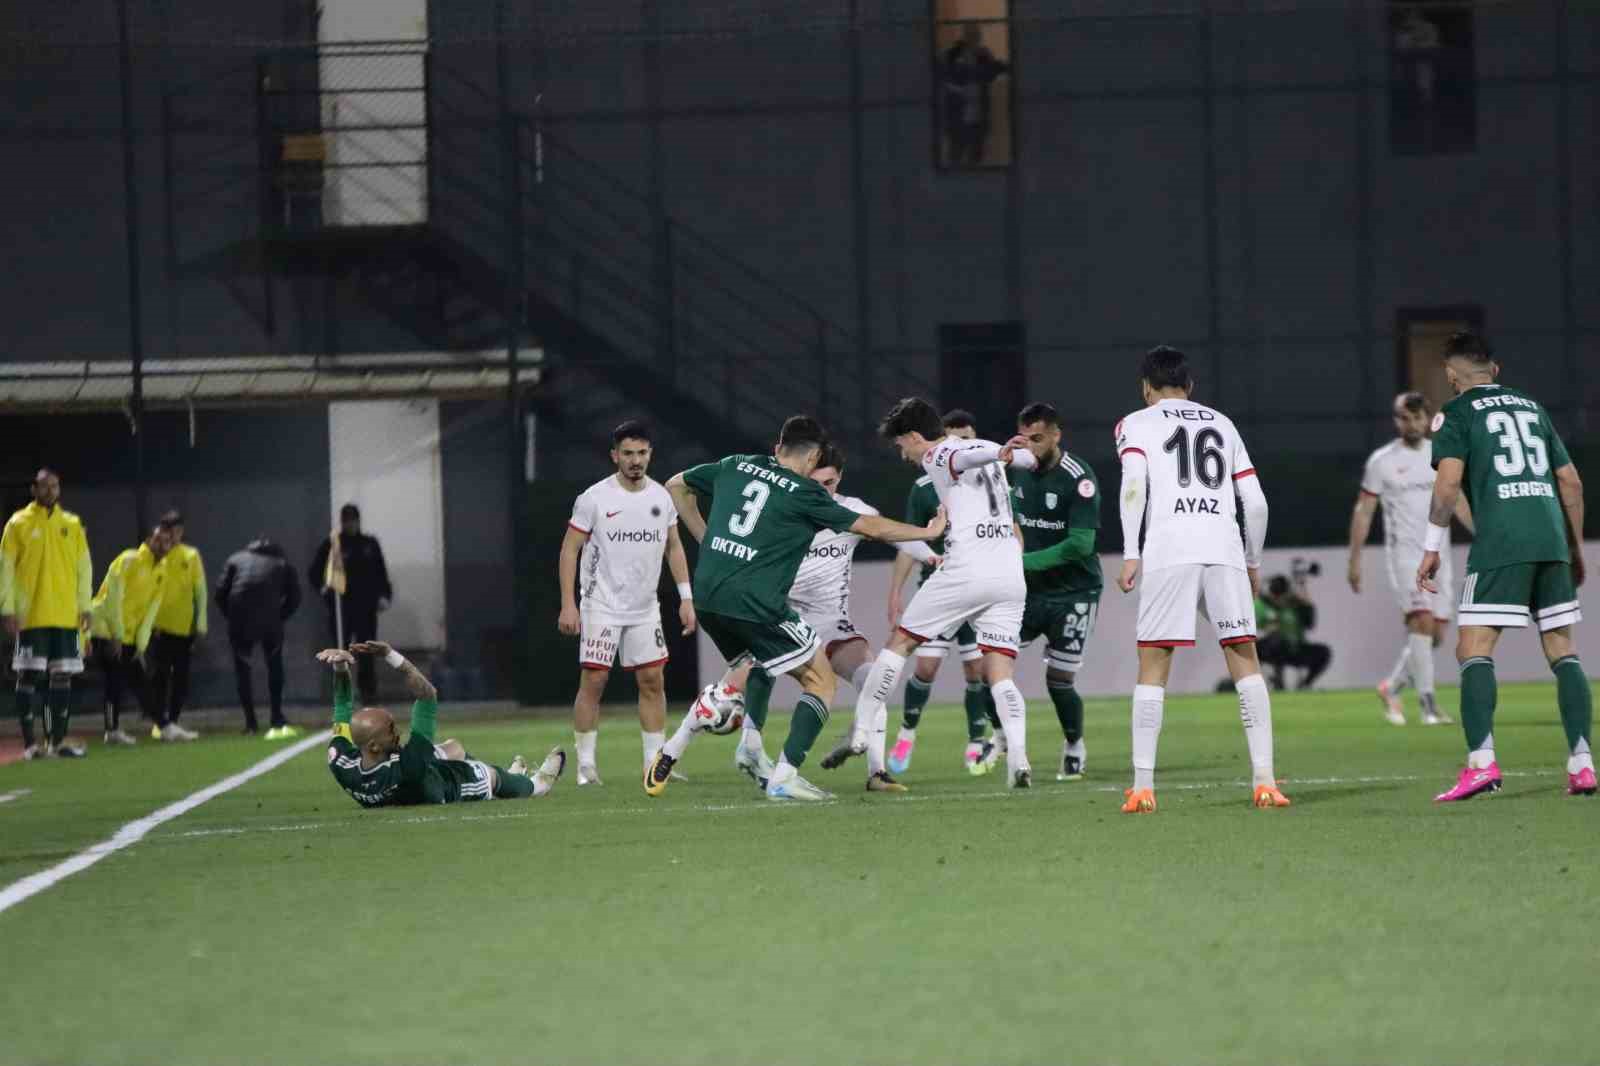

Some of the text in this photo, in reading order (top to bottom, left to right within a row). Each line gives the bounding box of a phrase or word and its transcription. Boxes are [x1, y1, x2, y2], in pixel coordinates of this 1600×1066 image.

[1162, 409, 1215, 421] NED
[1163, 425, 1227, 489] 16
[1486, 410, 1550, 477] 35
[736, 461, 800, 493] ESTENET
[728, 479, 771, 538] 3
[1174, 498, 1220, 515] AYAZ
[654, 628, 665, 648] 8
[1063, 613, 1089, 639] 24
